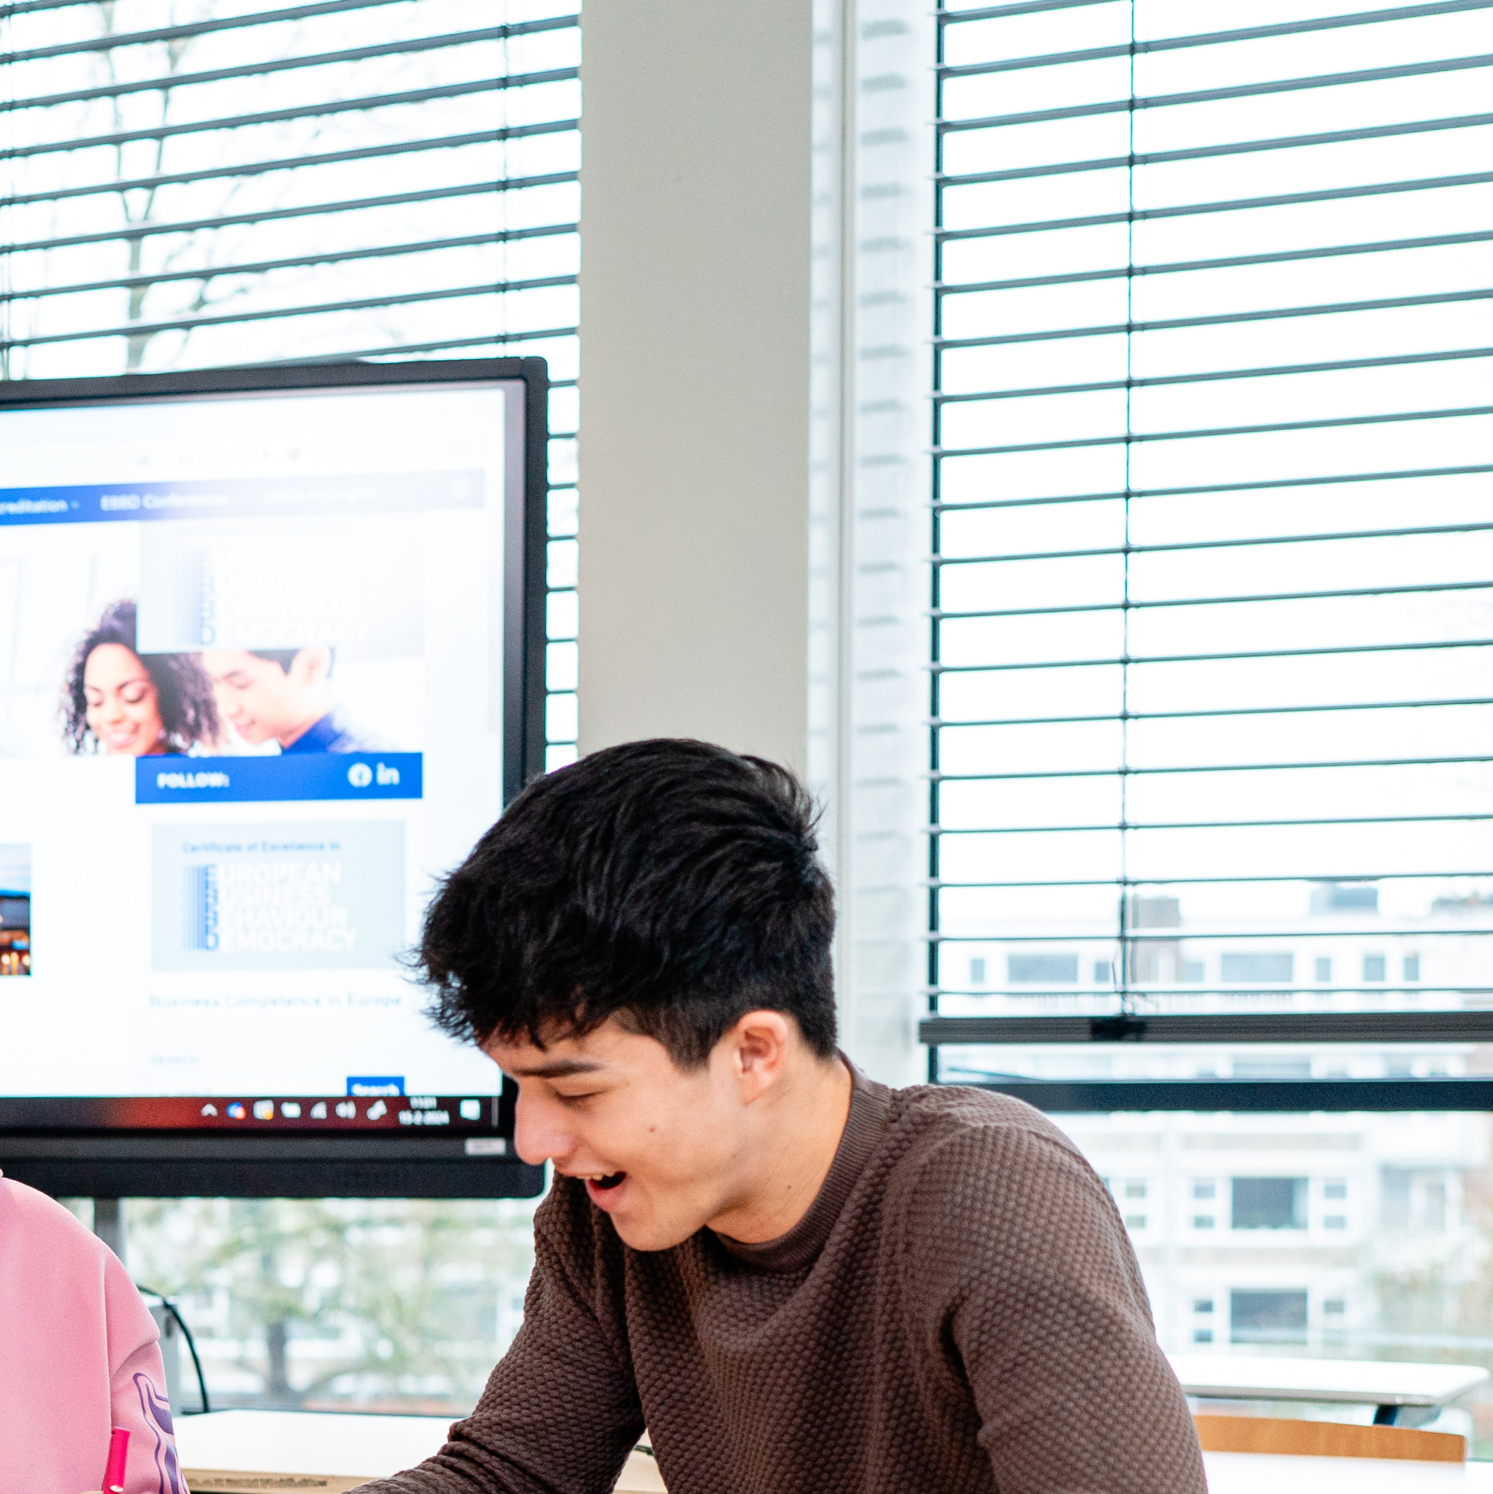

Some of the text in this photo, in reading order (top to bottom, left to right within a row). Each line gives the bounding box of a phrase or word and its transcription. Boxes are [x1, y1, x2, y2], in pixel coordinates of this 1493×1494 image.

[182, 839, 342, 854] Certificate of Excellence in
[150, 994, 403, 1009] Business Competence in Europe
